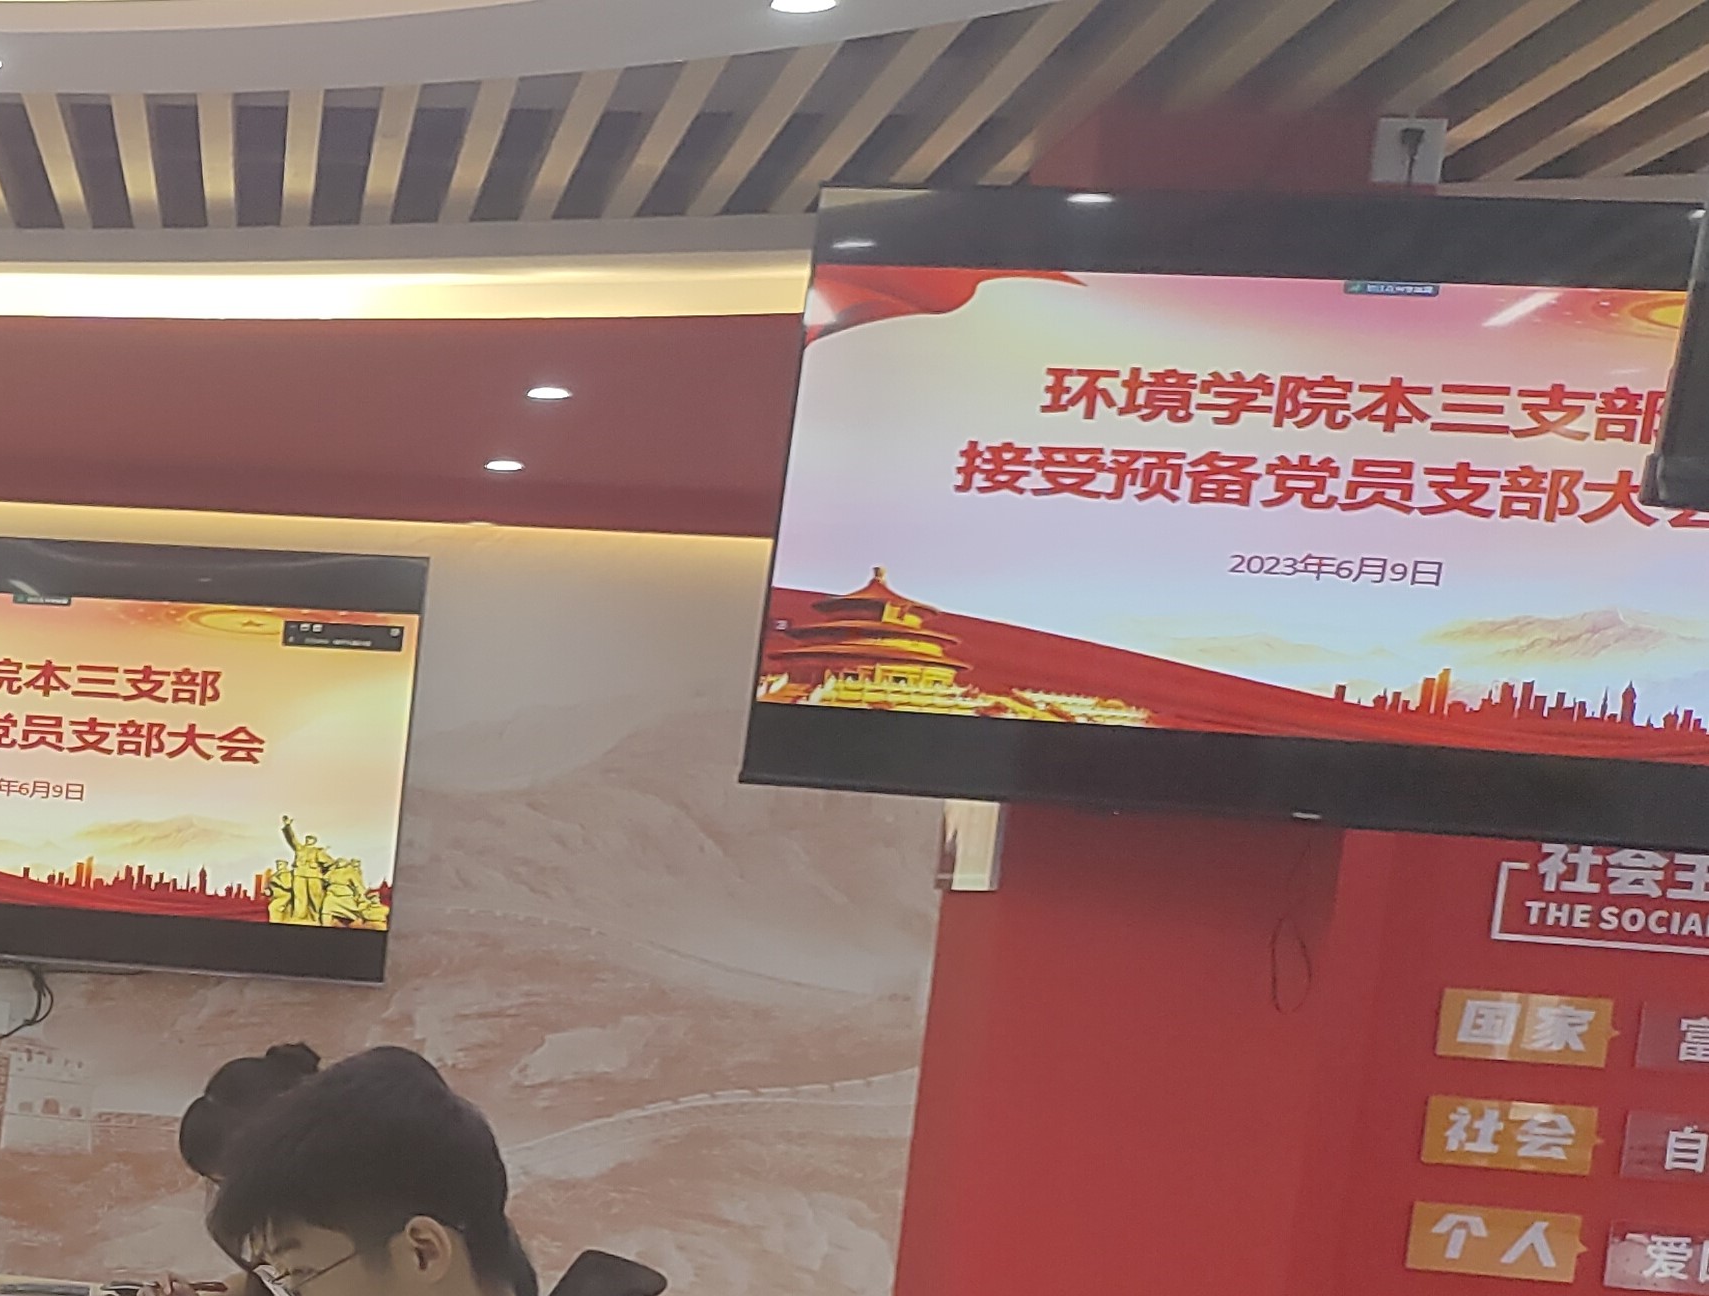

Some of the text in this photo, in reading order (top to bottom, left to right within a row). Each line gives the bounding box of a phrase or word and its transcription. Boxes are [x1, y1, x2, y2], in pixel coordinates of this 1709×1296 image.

[1041, 366, 1667, 445] 环境学院本三支部
[1229, 552, 1444, 588] 2023年6月9日
[1525, 901, 1709, 938] THE SOCIA
[1456, 999, 1596, 1053] 国家
[1445, 1106, 1574, 1161] 社会
[1664, 1125, 1709, 1173] 自
[1431, 1213, 1557, 1269] 个人
[1643, 1234, 1709, 1284] 爱
